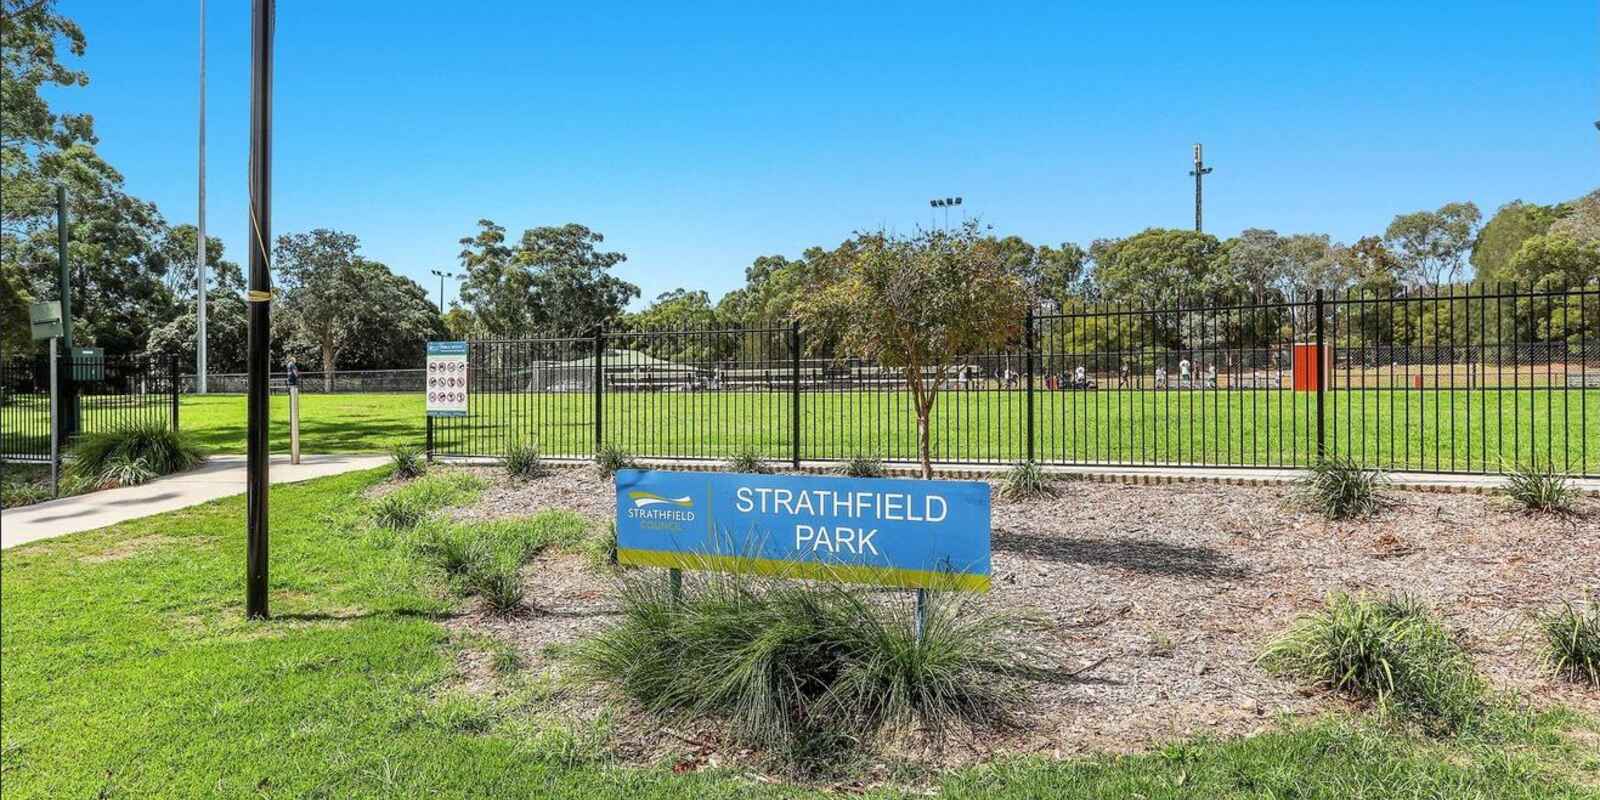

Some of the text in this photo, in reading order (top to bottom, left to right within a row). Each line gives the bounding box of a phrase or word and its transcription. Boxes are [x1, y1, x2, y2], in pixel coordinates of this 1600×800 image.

[628, 508, 695, 521] STRATHFIELD
[736, 487, 948, 522] STRATHFIELD
[796, 525, 878, 556] PARK
